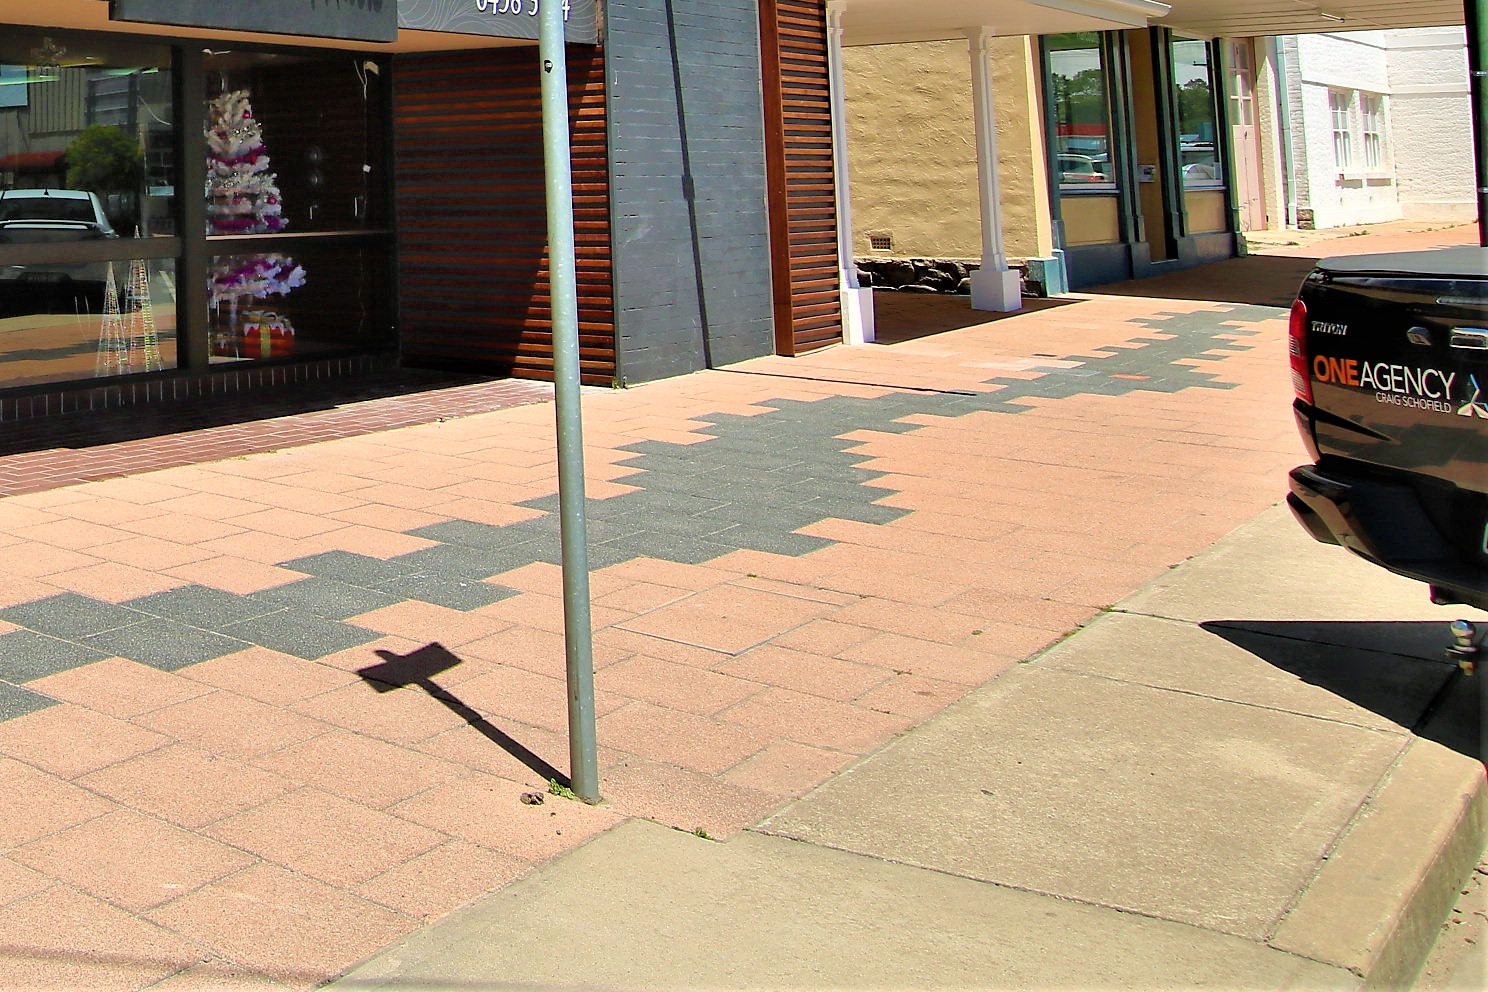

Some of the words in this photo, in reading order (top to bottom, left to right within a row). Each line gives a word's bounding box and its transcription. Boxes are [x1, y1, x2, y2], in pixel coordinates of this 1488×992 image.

[1311, 320, 1348, 336] TRITON
[1375, 391, 1402, 406] CRAIG
[1402, 395, 1452, 414] SCHOFIELD
